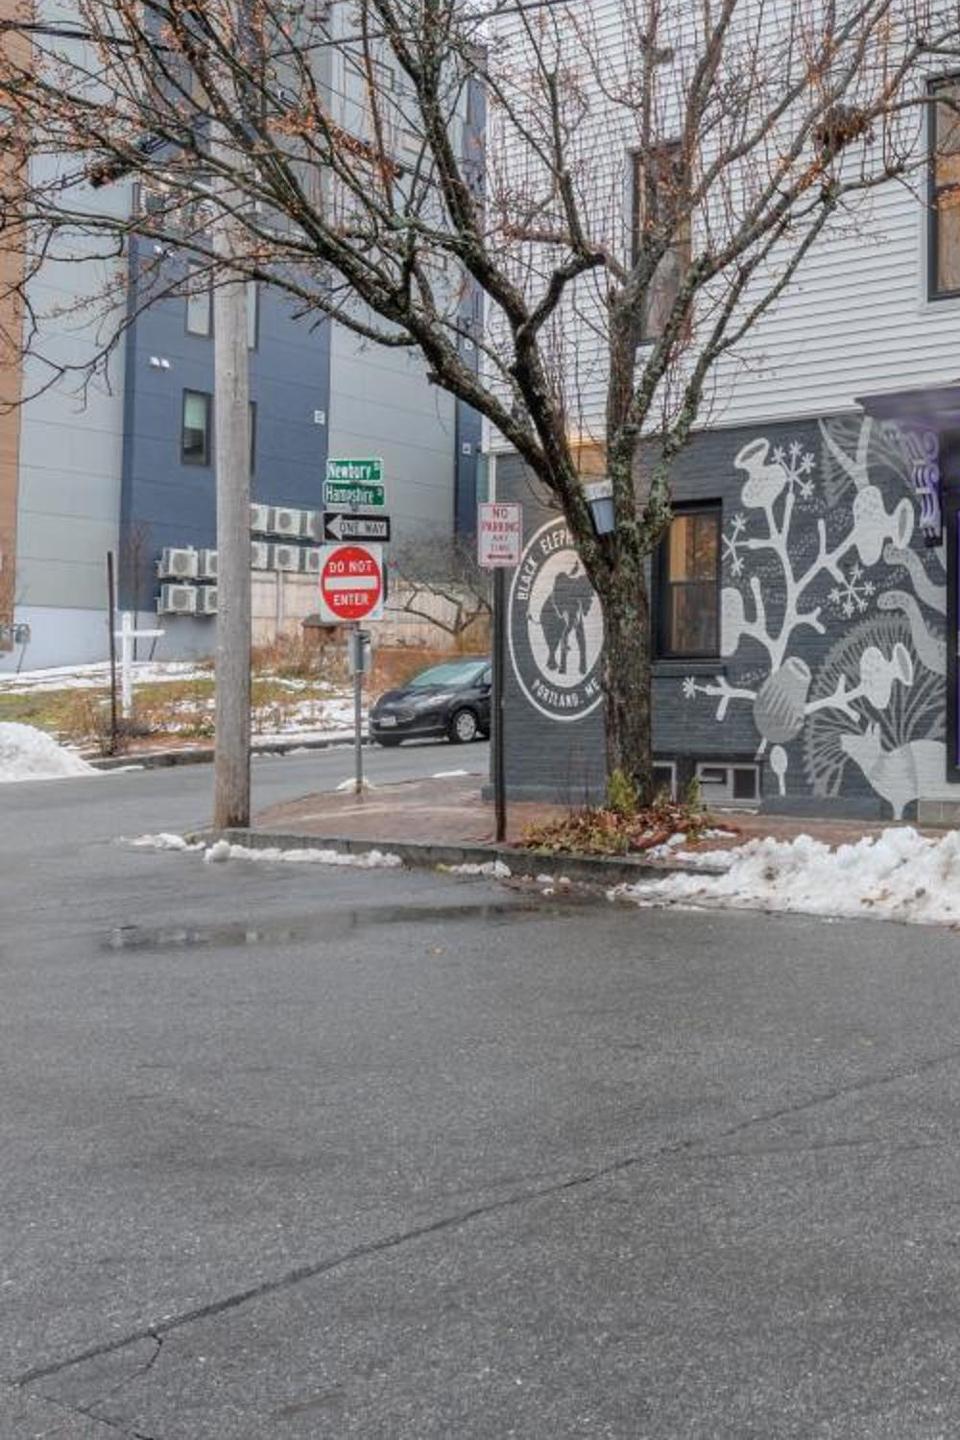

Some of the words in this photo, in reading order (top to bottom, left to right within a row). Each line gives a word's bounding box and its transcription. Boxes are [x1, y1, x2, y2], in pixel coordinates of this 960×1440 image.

[327, 462, 372, 480] Newbury
[326, 484, 374, 503] Hampshire
[492, 507, 509, 519] NO
[341, 521, 360, 534] ONE
[364, 521, 385, 535] WAY
[481, 521, 520, 532] PARKING
[329, 561, 345, 574] DO
[348, 560, 373, 573] NOT
[516, 556, 539, 601] BLACK
[540, 528, 575, 556] ELEPH
[333, 592, 369, 606] ENTER
[584, 676, 600, 698] ME
